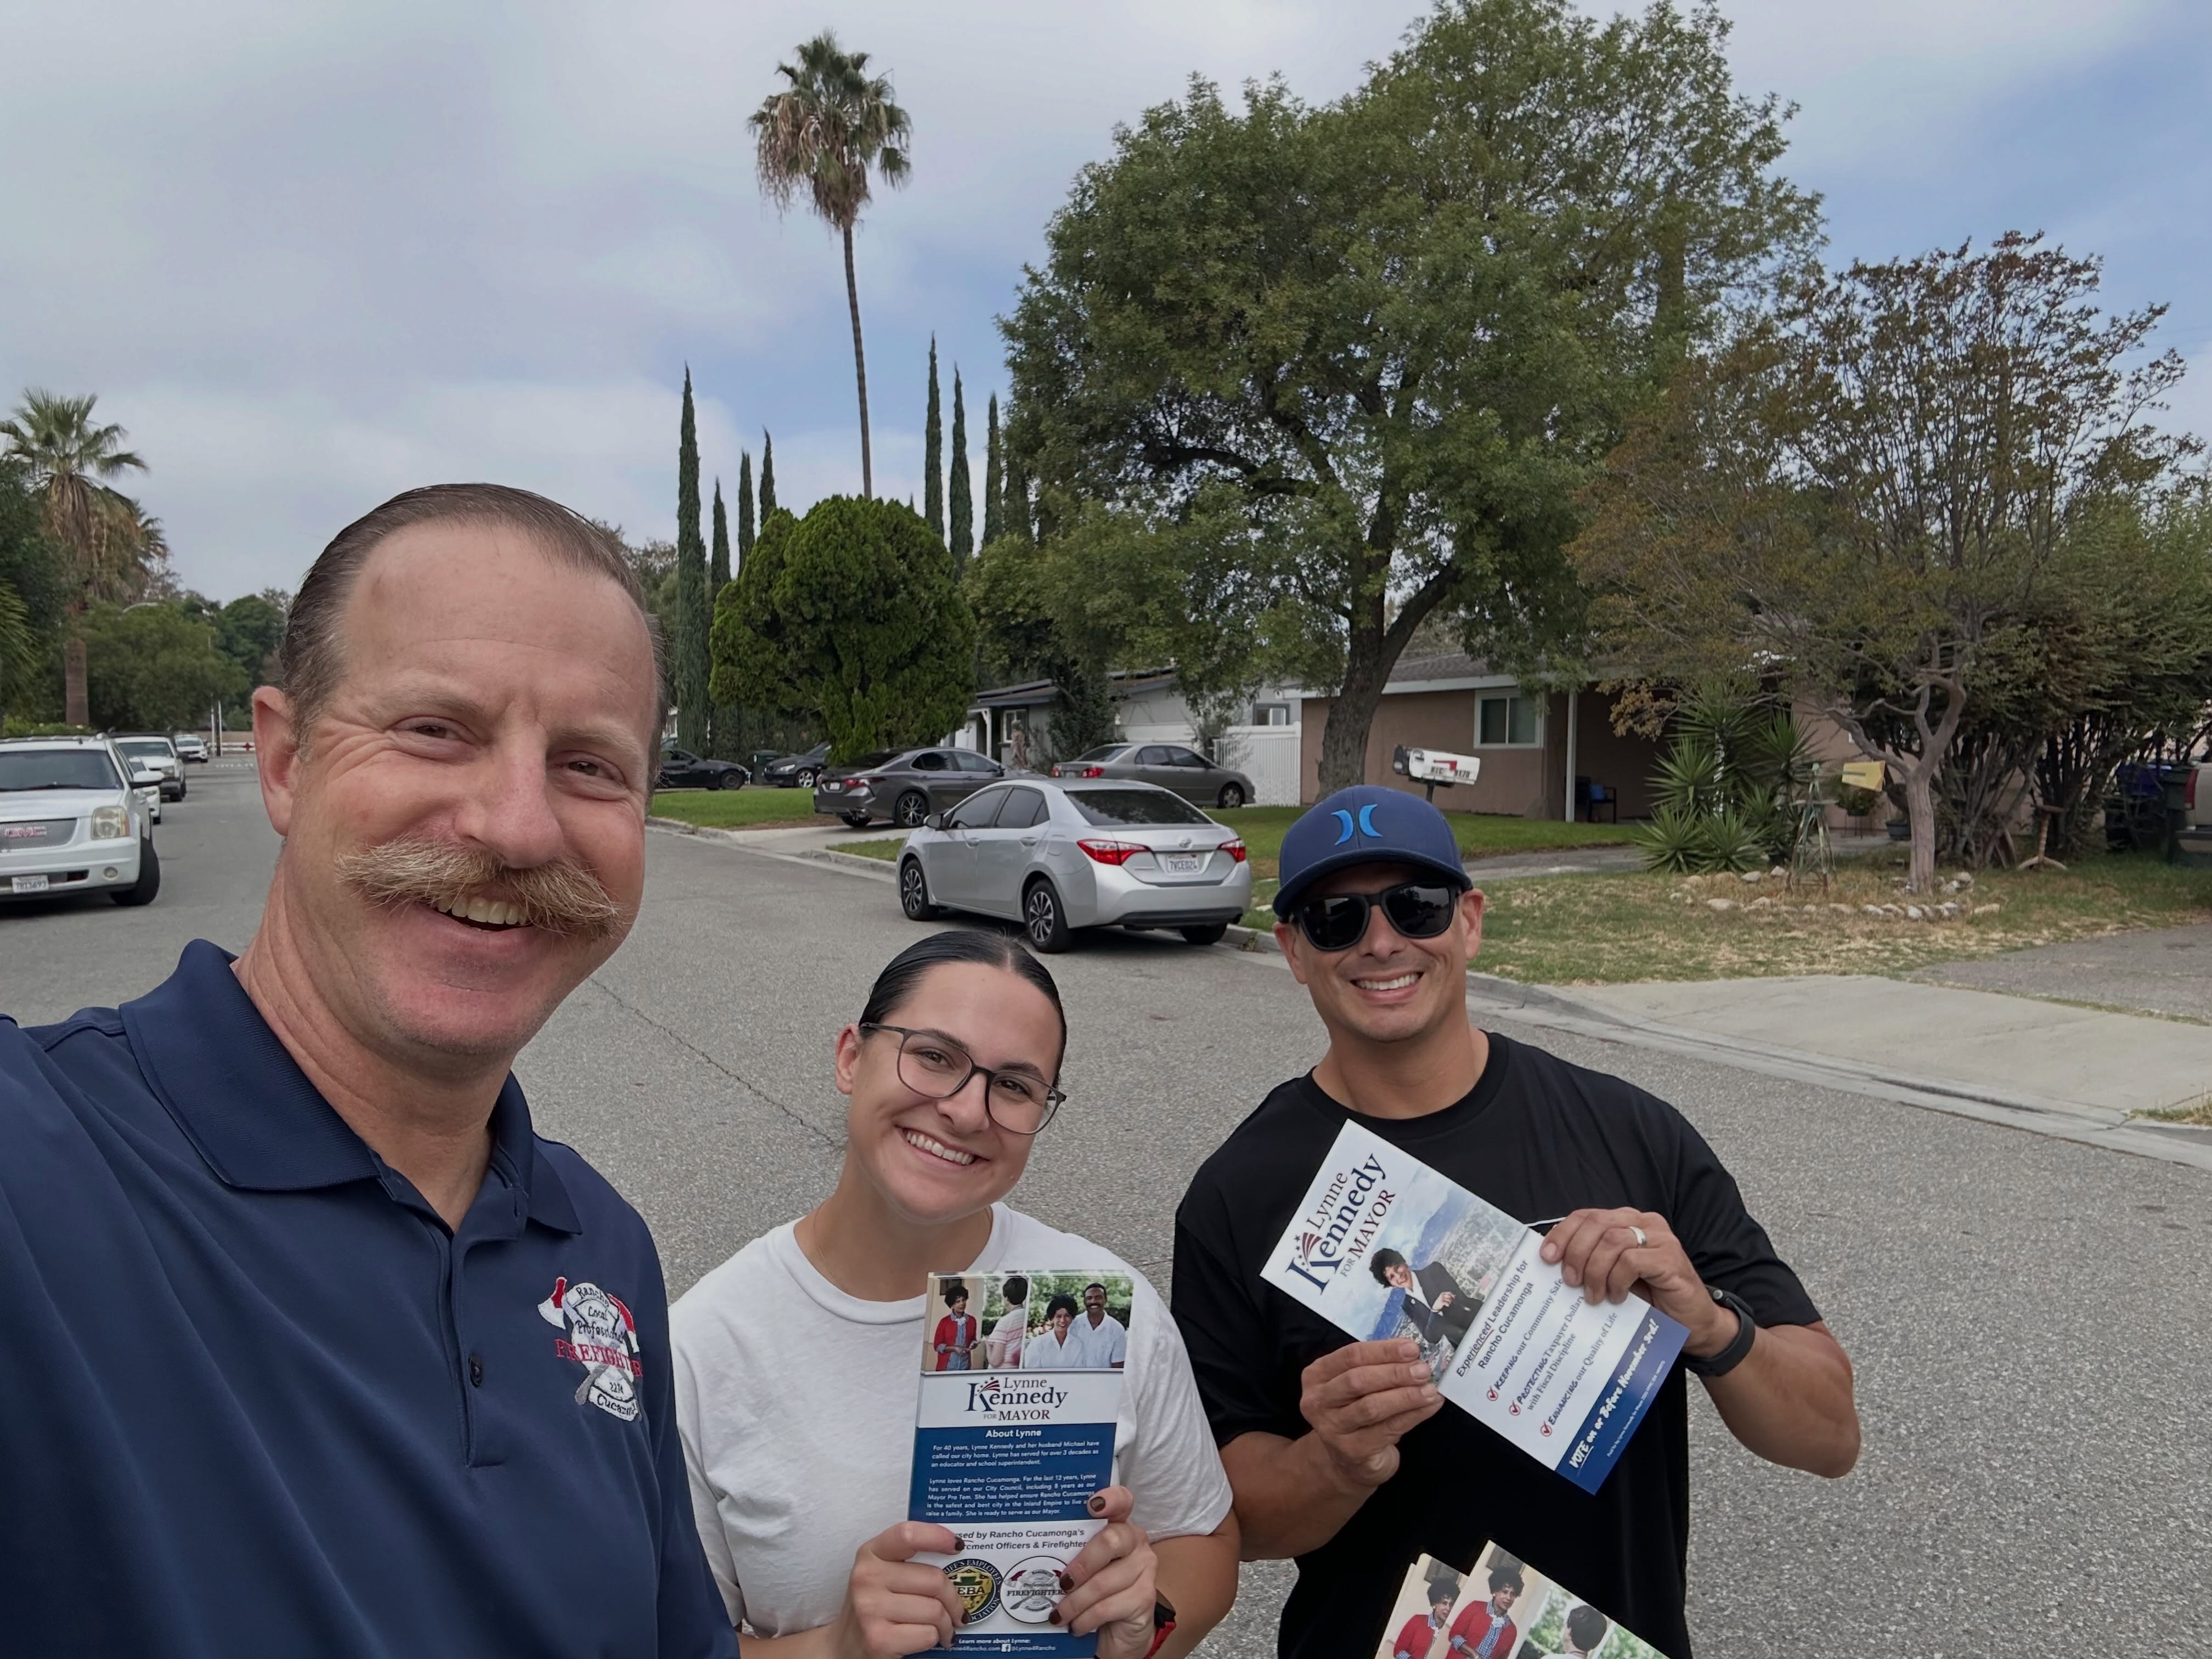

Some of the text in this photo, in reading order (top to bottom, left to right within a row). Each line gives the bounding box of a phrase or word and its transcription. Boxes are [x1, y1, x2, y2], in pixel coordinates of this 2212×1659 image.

[1285, 1153, 1386, 1296] Kennedy
[1306, 1172, 1348, 1231] Lynne
[1340, 1189, 1396, 1277] FOR MAYOR
[1456, 1260, 1528, 1377] Experienced Leadership for
[1478, 1281, 1534, 1369] Rancho Cucamonga
[1494, 1278, 1564, 1390] KEEPING our Community Safe
[1516, 1295, 1584, 1405] PROTECTING Taxpayer Dollars
[964, 1383, 1069, 1412] Kennedy
[1003, 1377, 1047, 1392] Lynne
[1527, 1332, 1577, 1411] with Fiscal Discipline
[1548, 1312, 1618, 1425] ENHANCING our Quality of Life
[1568, 1318, 1659, 1469] VOTE on or Before November 3rd!
[985, 1430, 1041, 1438] About Lynne
[998, 1410, 1051, 1421] MAYOR
[977, 1531, 987, 1539] by
[1026, 1529, 1085, 1537] Cucamonga's
[1042, 1541, 1088, 1549] Firefighter
[957, 1587, 985, 1595] EBA
